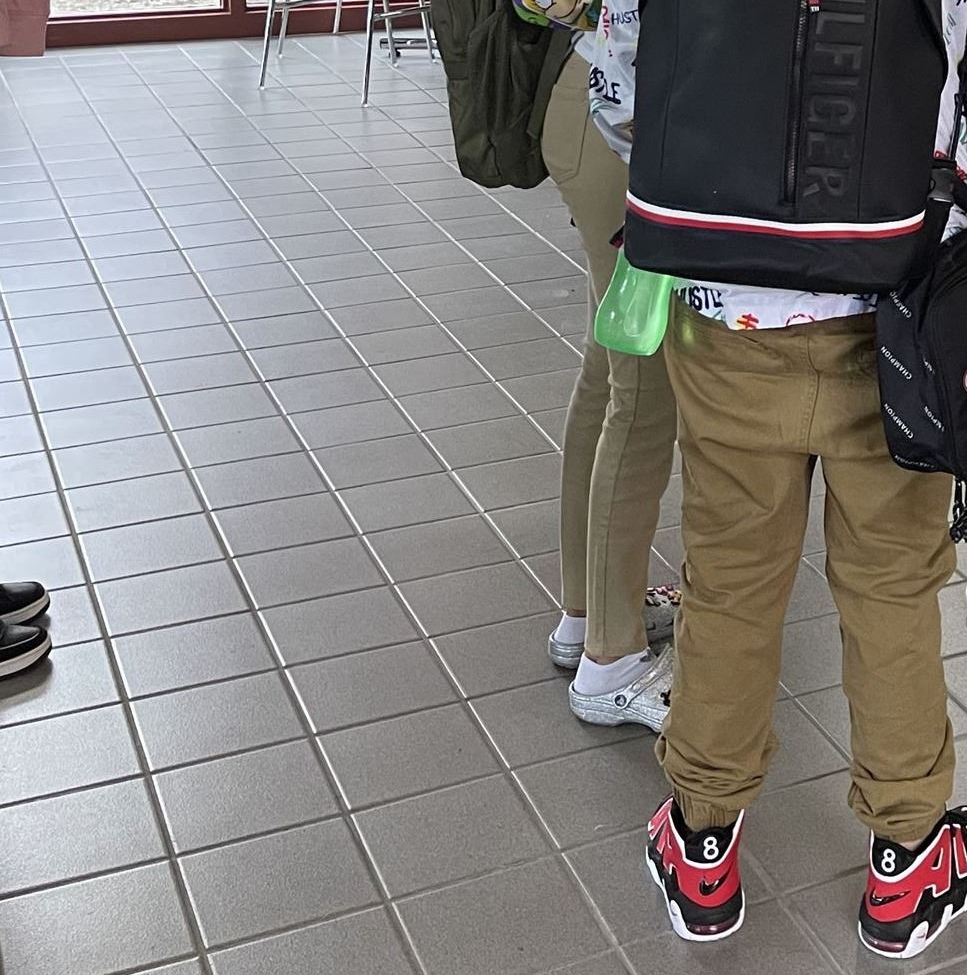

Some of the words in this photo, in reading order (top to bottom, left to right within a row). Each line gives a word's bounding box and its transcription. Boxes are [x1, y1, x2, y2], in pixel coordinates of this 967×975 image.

[880, 345, 912, 380] CHAMPION
[884, 403, 914, 439] CHAMPION
[702, 836, 720, 861] 8
[880, 848, 897, 873] 8
